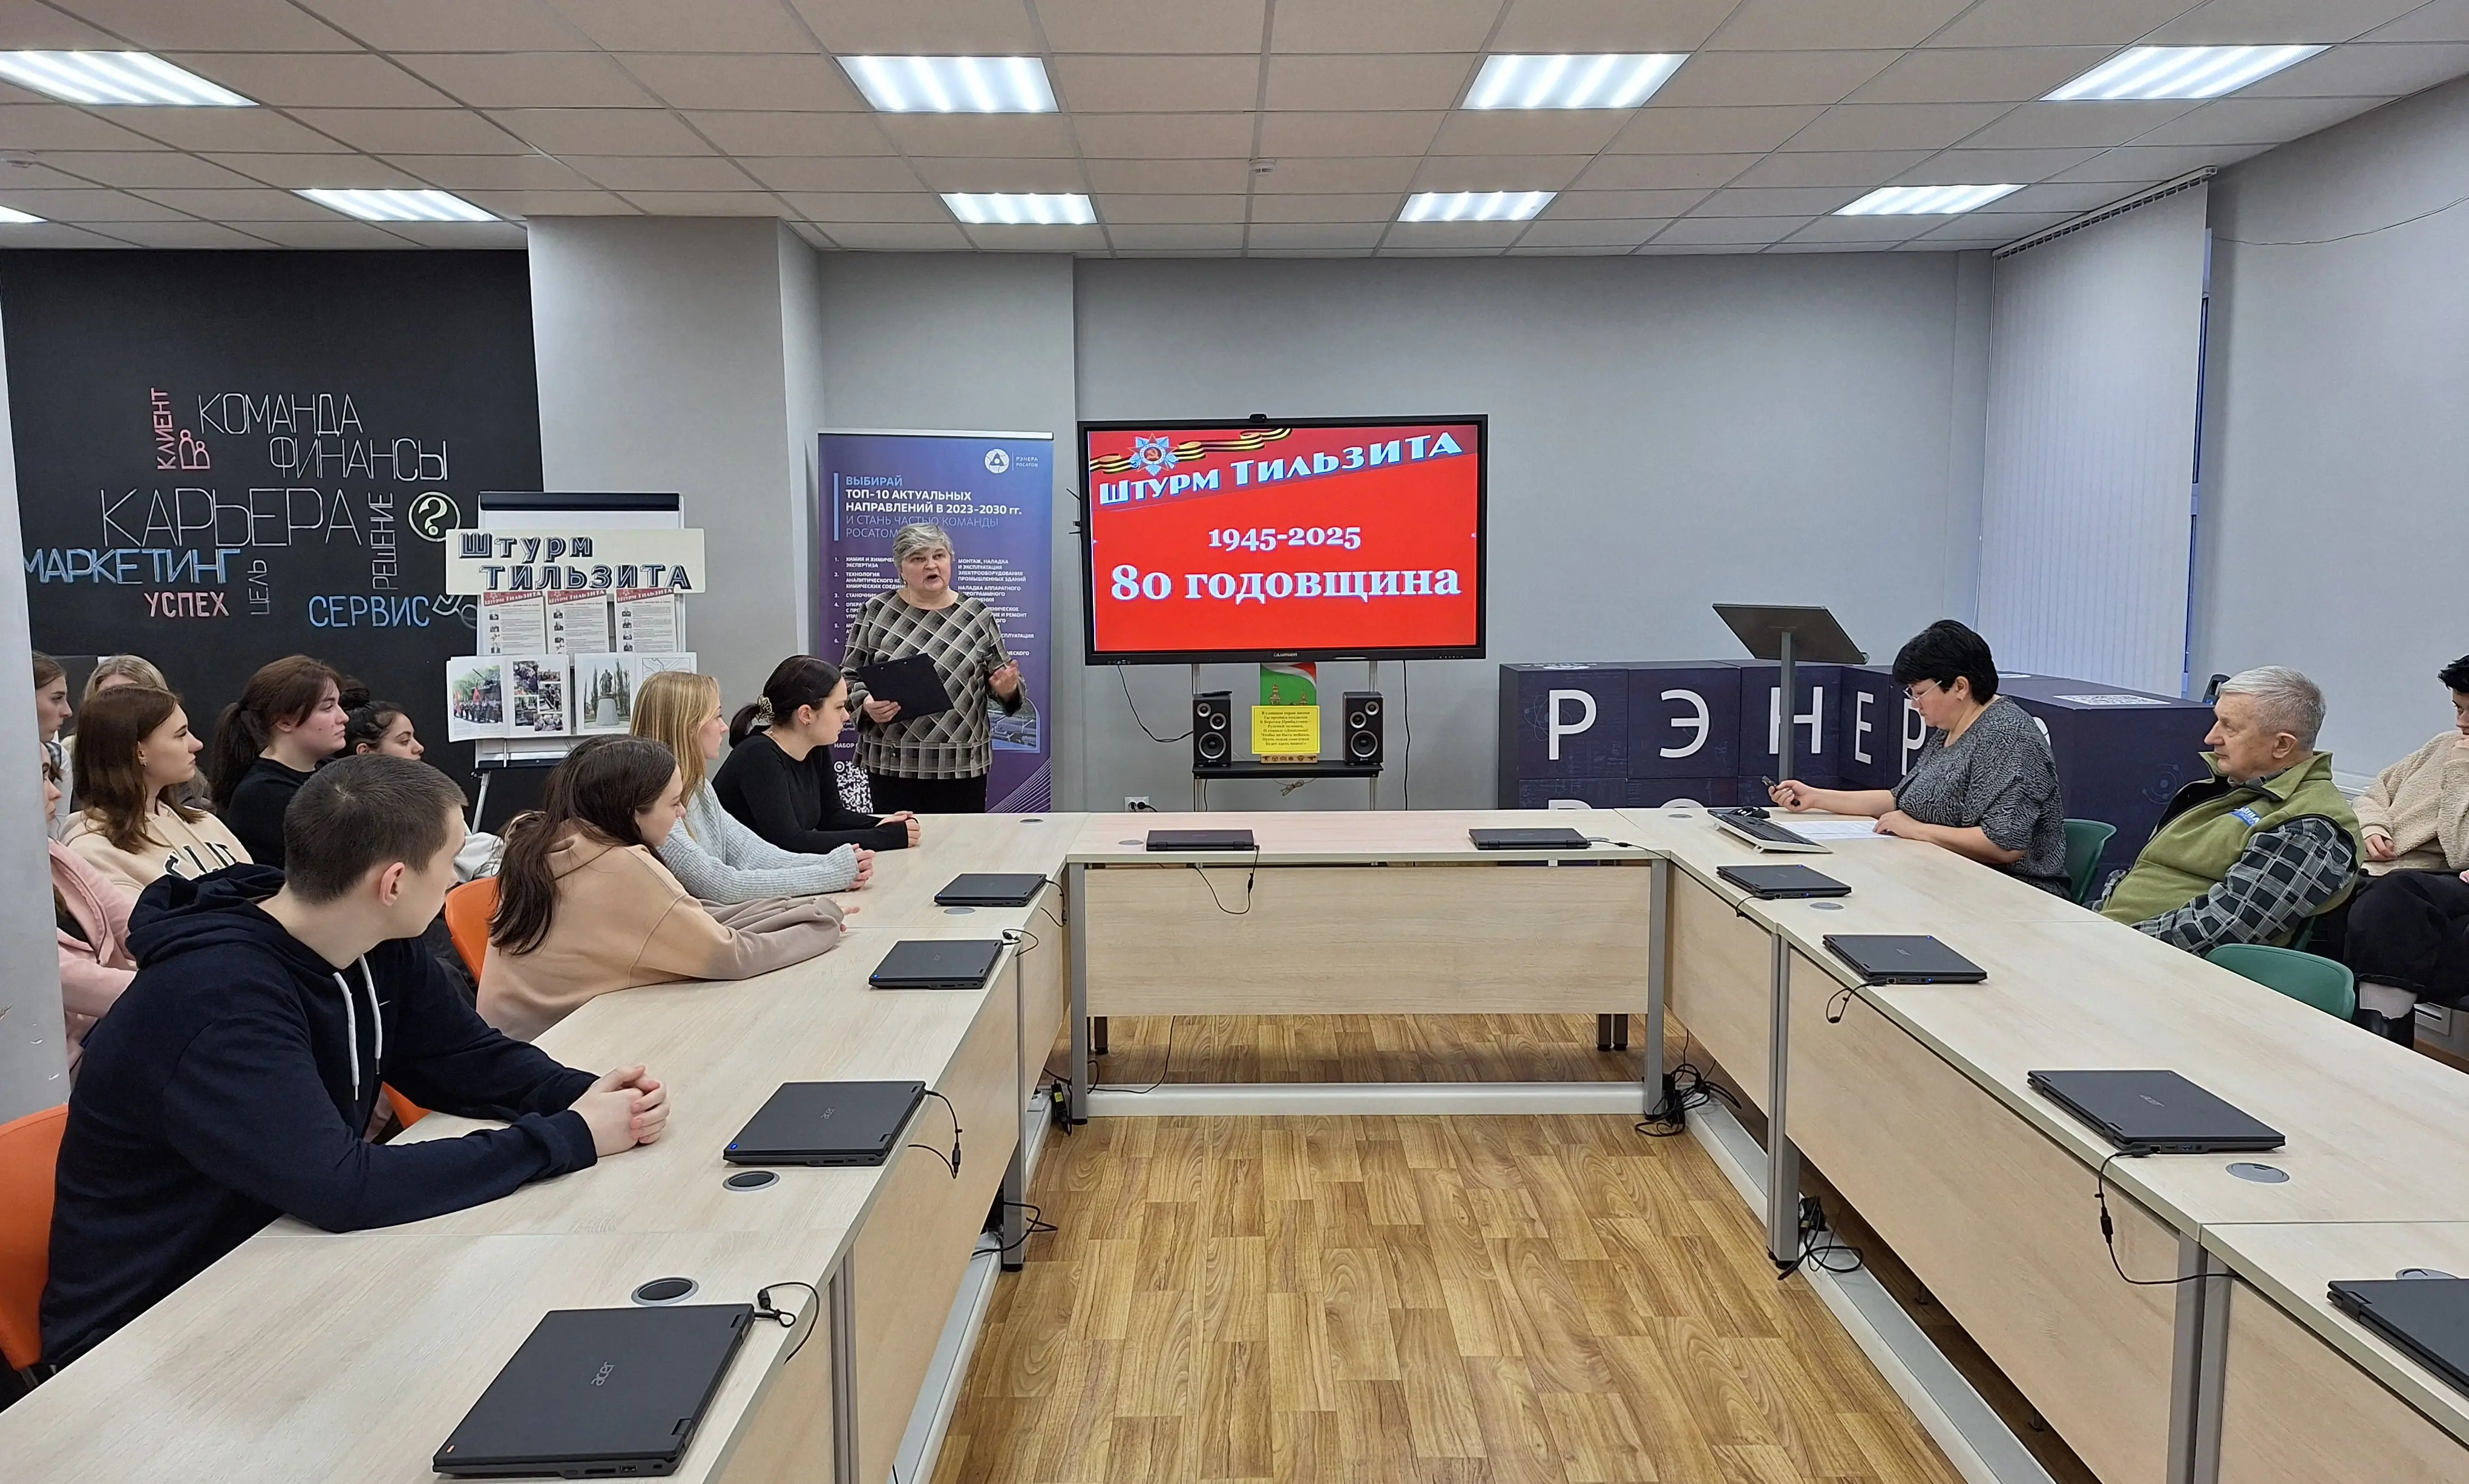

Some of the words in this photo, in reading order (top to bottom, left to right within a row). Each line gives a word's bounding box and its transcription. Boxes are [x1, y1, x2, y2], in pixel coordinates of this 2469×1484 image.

[150, 387, 177, 470] КЛИЕНТ
[197, 393, 364, 437] КОМАНДА
[269, 436, 448, 482] ФИНАНСЫ
[845, 475, 903, 486] ВЫБИРАЙ
[845, 489, 890, 499] ТОП-10
[891, 490, 972, 501] АКТУАЛЬНЫХ
[1099, 469, 1219, 506] ШТУРМ
[100, 487, 362, 547] КАРЬЕРА
[845, 501, 933, 514] НАПРАВЛЕНИЙ
[936, 504, 943, 513] В
[1009, 506, 1022, 515] гг.
[846, 515, 853, 525] И
[855, 515, 891, 525] СТАНЬ
[894, 516, 939, 526] ЧАСТЬЮ
[942, 517, 998, 528] КОМАНДЫ
[367, 491, 399, 590] РЕШЕНИЕ
[1208, 526, 1362, 551] 1945-2025
[24, 548, 240, 584] МАРКЕТИНГ
[247, 560, 271, 615] ЦЕЛЬ
[1111, 564, 1172, 601] 80
[1184, 567, 1462, 605] годовщина
[143, 591, 229, 618] УСПЕХ
[308, 595, 430, 627] СЕРВИС
[591, 1361, 614, 1385] acer
